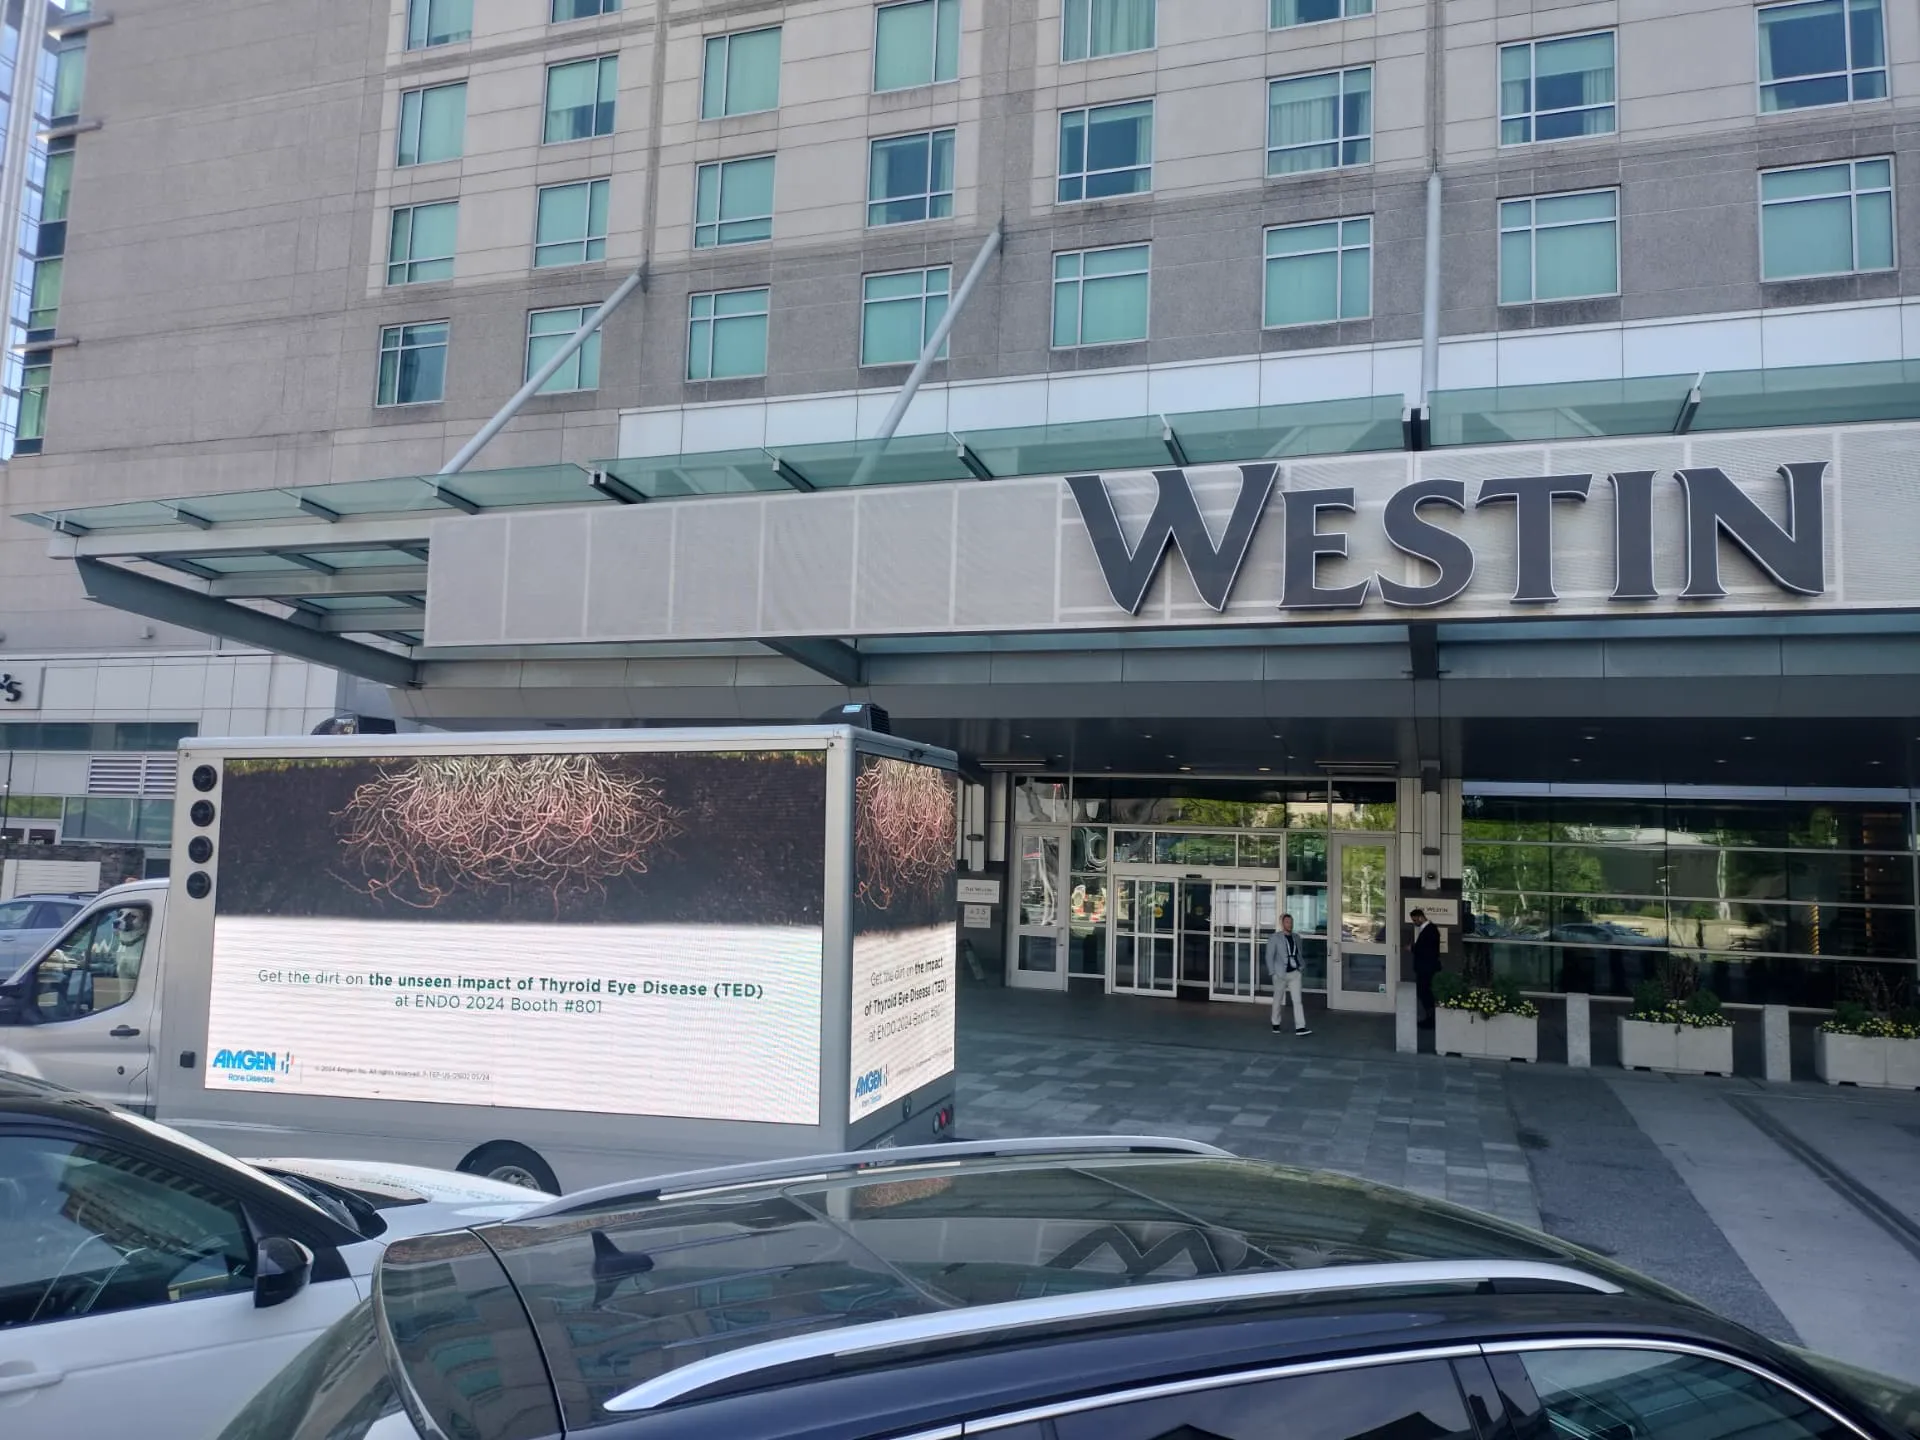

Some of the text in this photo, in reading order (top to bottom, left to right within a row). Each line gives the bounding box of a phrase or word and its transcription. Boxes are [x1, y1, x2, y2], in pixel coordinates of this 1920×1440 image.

[1063, 461, 1830, 616] WESTIN
[914, 960, 924, 974] the
[925, 956, 943, 974] impact
[258, 970, 764, 1000] Get the dirt on the unseen impact of Thyroid Eye Disease (TED)
[864, 978, 947, 1016] of Thyroid Eye Disease (TED)
[395, 994, 602, 1014] at ENDO 2024 Booth #801
[212, 1048, 276, 1071] AMGEN
[228, 1073, 275, 1084] Rare Disease
[855, 1067, 882, 1099] AMGEN
